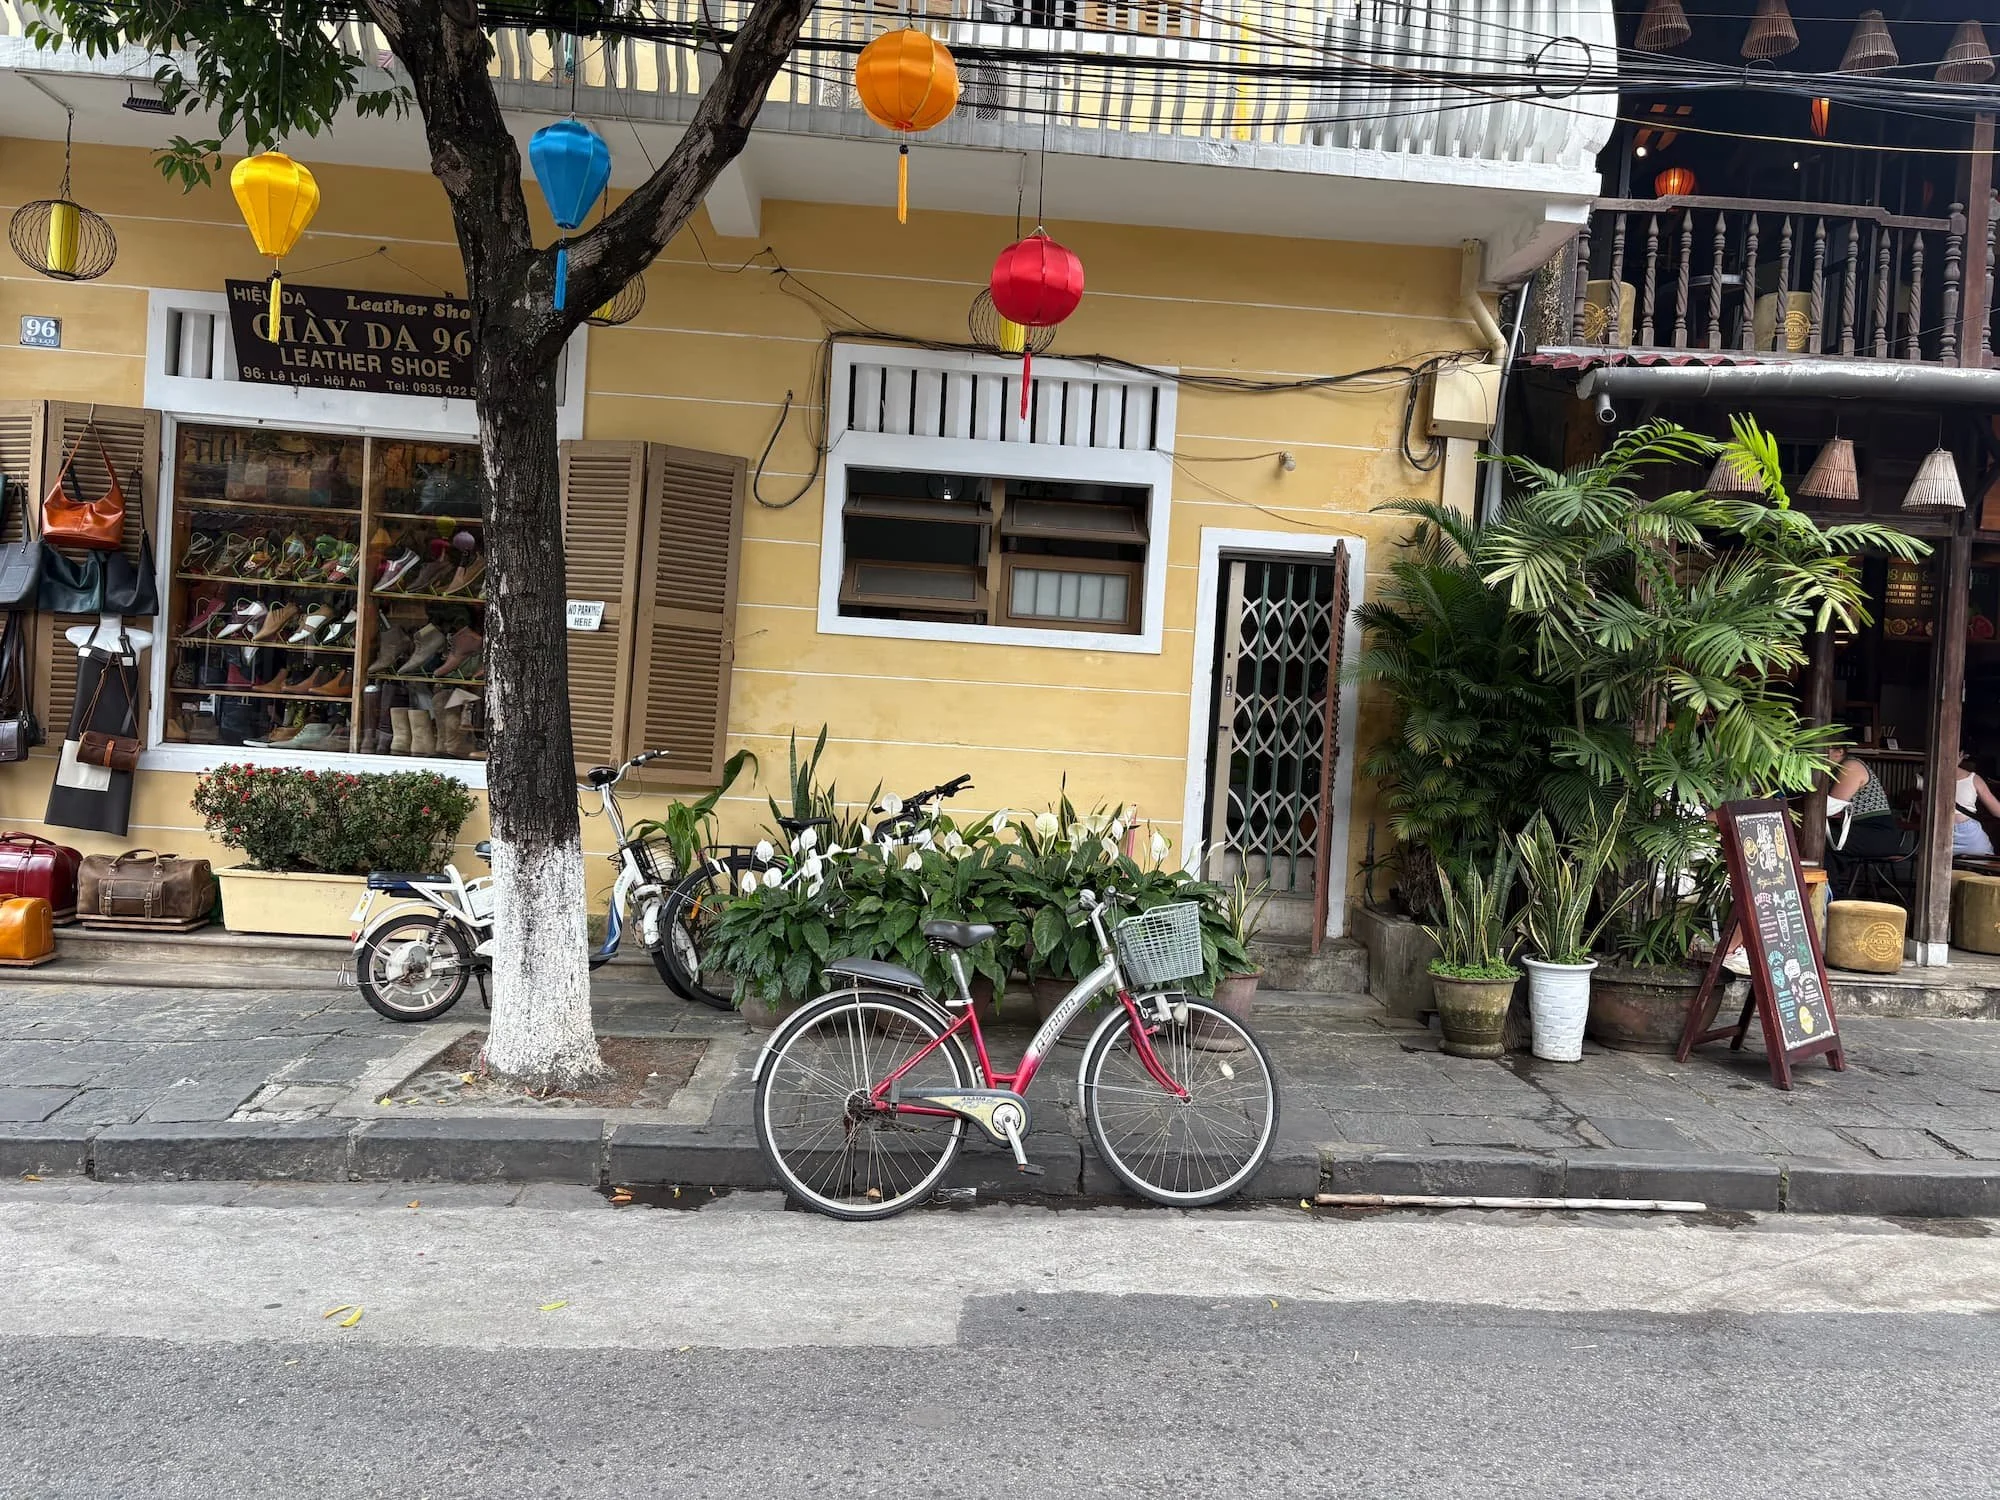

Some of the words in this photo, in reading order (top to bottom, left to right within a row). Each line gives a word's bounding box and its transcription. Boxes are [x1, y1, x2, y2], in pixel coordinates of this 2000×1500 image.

[282, 292, 306, 306] DA
[347, 296, 427, 316] Leather
[433, 303, 471, 319] Sho
[26, 319, 56, 337] 96
[364, 322, 420, 353] DA
[433, 327, 472, 357] 96
[280, 347, 382, 374] LEATHER
[391, 356, 451, 379] SHOE
[243, 366, 265, 380] 96:
[270, 370, 285, 382] Lê
[290, 372, 310, 385] Lợi
[323, 375, 345, 388] Hội
[349, 378, 366, 389] An
[386, 380, 409, 392] Tel:
[413, 382, 442, 394] 0935
[446, 385, 467, 396] 422
[568, 604, 577, 615] NO
[573, 617, 592, 627] HERE
[1754, 892, 1772, 906] COFFEE
[1035, 998, 1076, 1054] ASAMA
